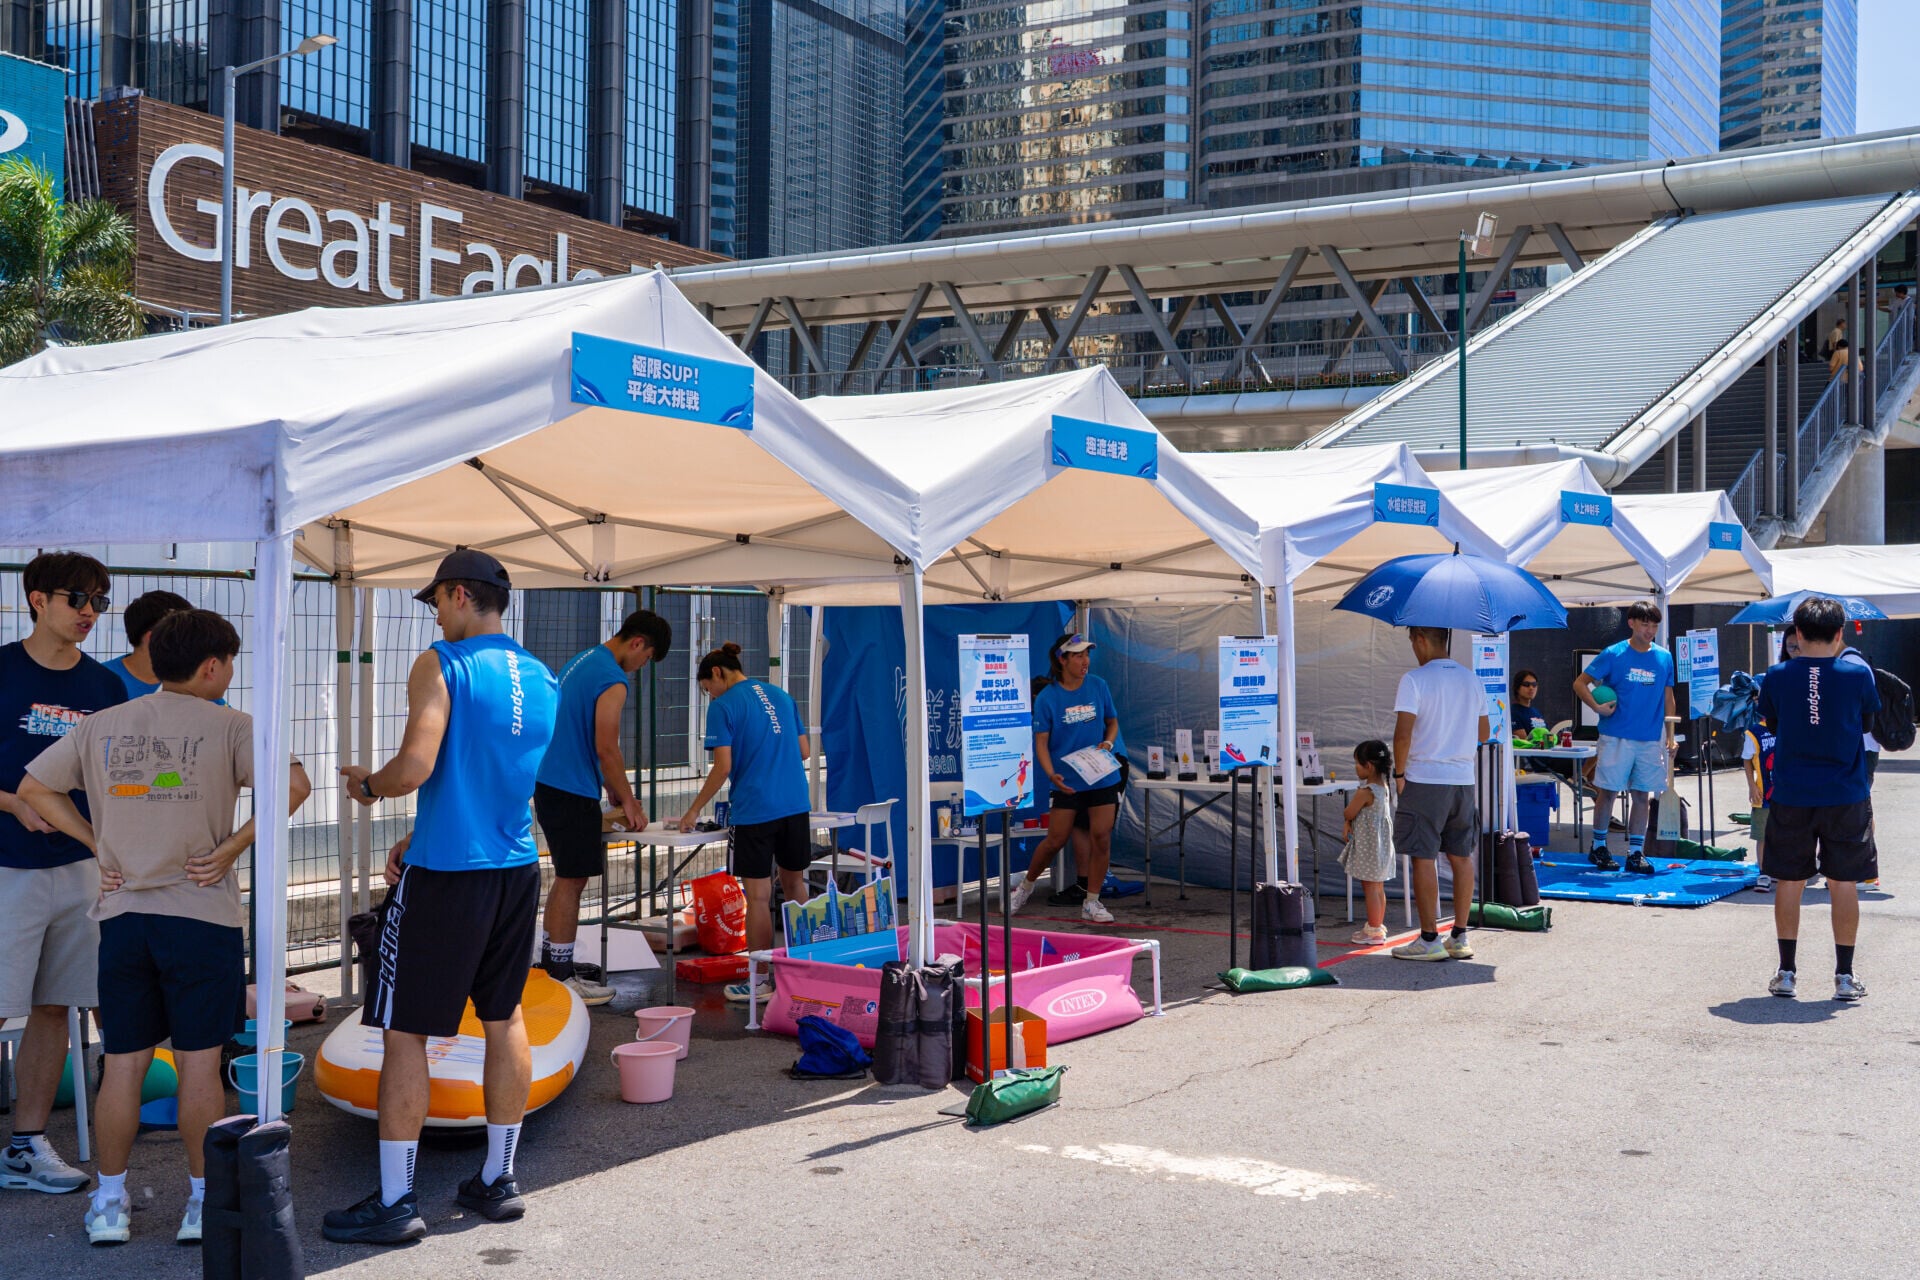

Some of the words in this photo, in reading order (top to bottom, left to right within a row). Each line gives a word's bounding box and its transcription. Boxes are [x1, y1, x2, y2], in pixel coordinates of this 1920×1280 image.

[148, 143, 405, 299] Great
[420, 202, 603, 304] Eagl
[627, 380, 700, 412] 平衡大挑戰
[504, 649, 524, 736] WaterSports
[751, 684, 782, 734] WaterSports
[1807, 666, 1821, 725] WaterSports
[1060, 992, 1098, 1013] INTEX
